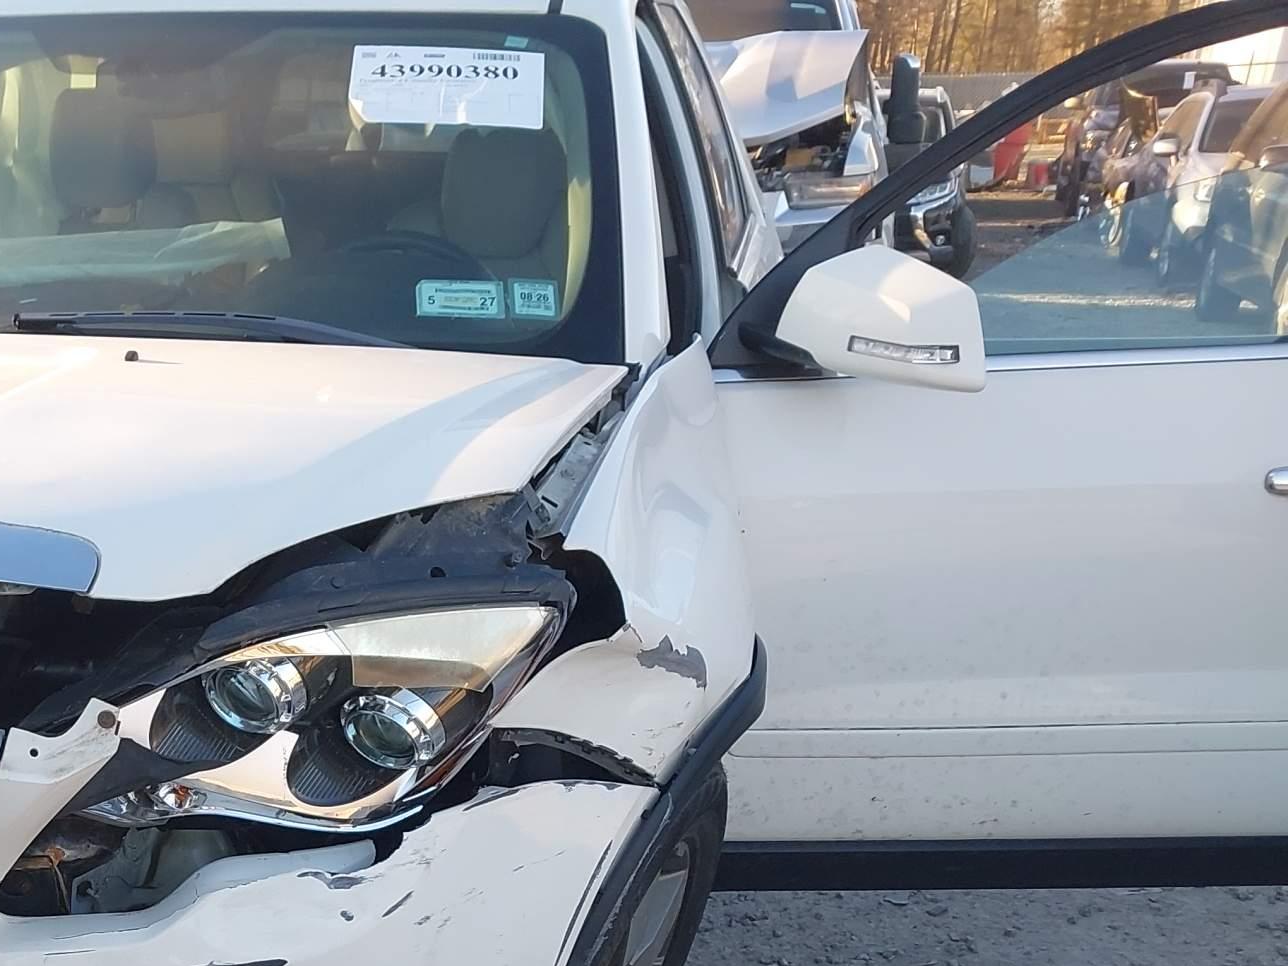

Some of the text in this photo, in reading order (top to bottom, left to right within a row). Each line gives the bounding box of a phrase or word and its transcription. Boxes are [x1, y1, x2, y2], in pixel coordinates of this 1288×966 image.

[371, 64, 519, 80] 43990380
[427, 295, 436, 305] 5
[479, 296, 496, 307] 27
